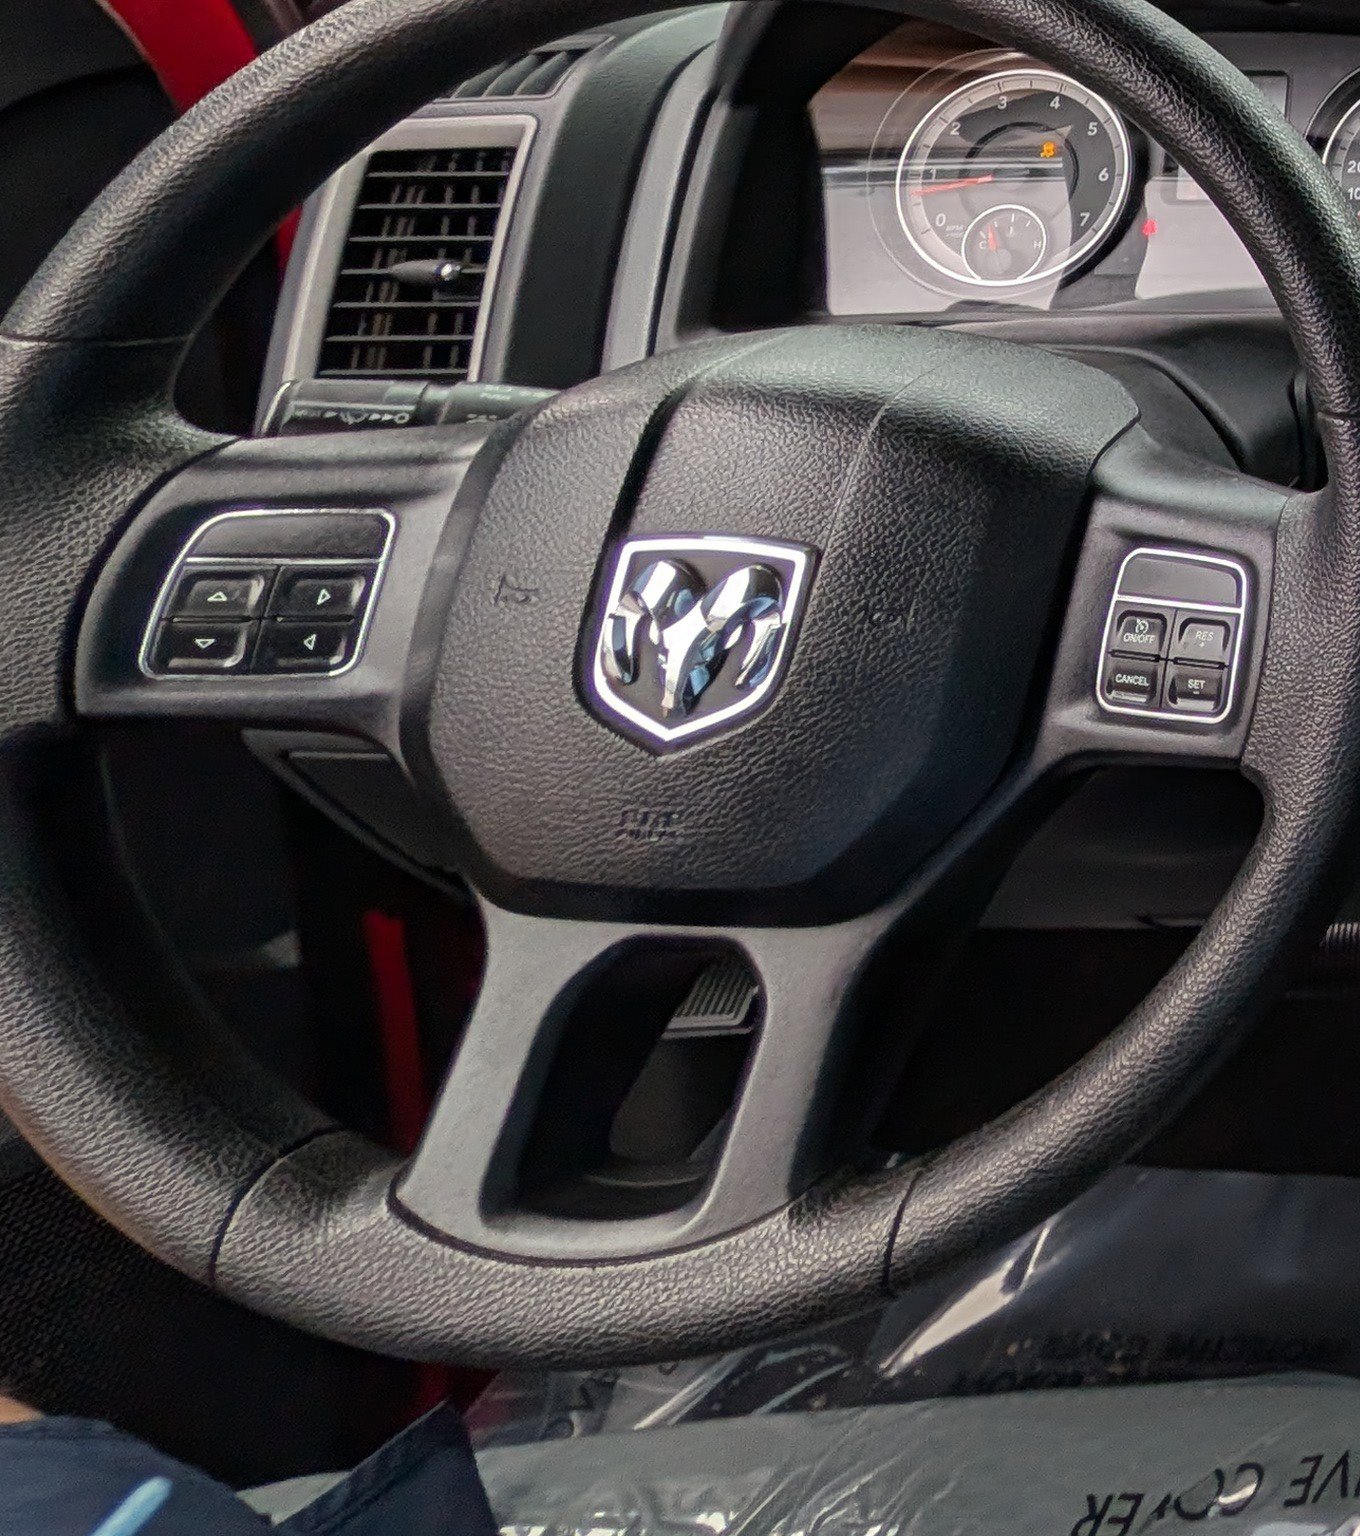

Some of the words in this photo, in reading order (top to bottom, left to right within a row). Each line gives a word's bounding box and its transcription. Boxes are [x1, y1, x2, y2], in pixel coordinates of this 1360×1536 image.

[997, 96, 1007, 110] 3
[1049, 96, 1060, 109] 4
[950, 123, 960, 136] 2
[1088, 122, 1098, 136] 5
[1098, 168, 1109, 182] 6
[935, 213, 946, 227] 0
[1080, 212, 1090, 226] 7
[1123, 632, 1156, 644] ON/OFF
[1195, 631, 1214, 641] RES
[1115, 674, 1150, 686] CANCEL
[1188, 679, 1206, 690] SET
